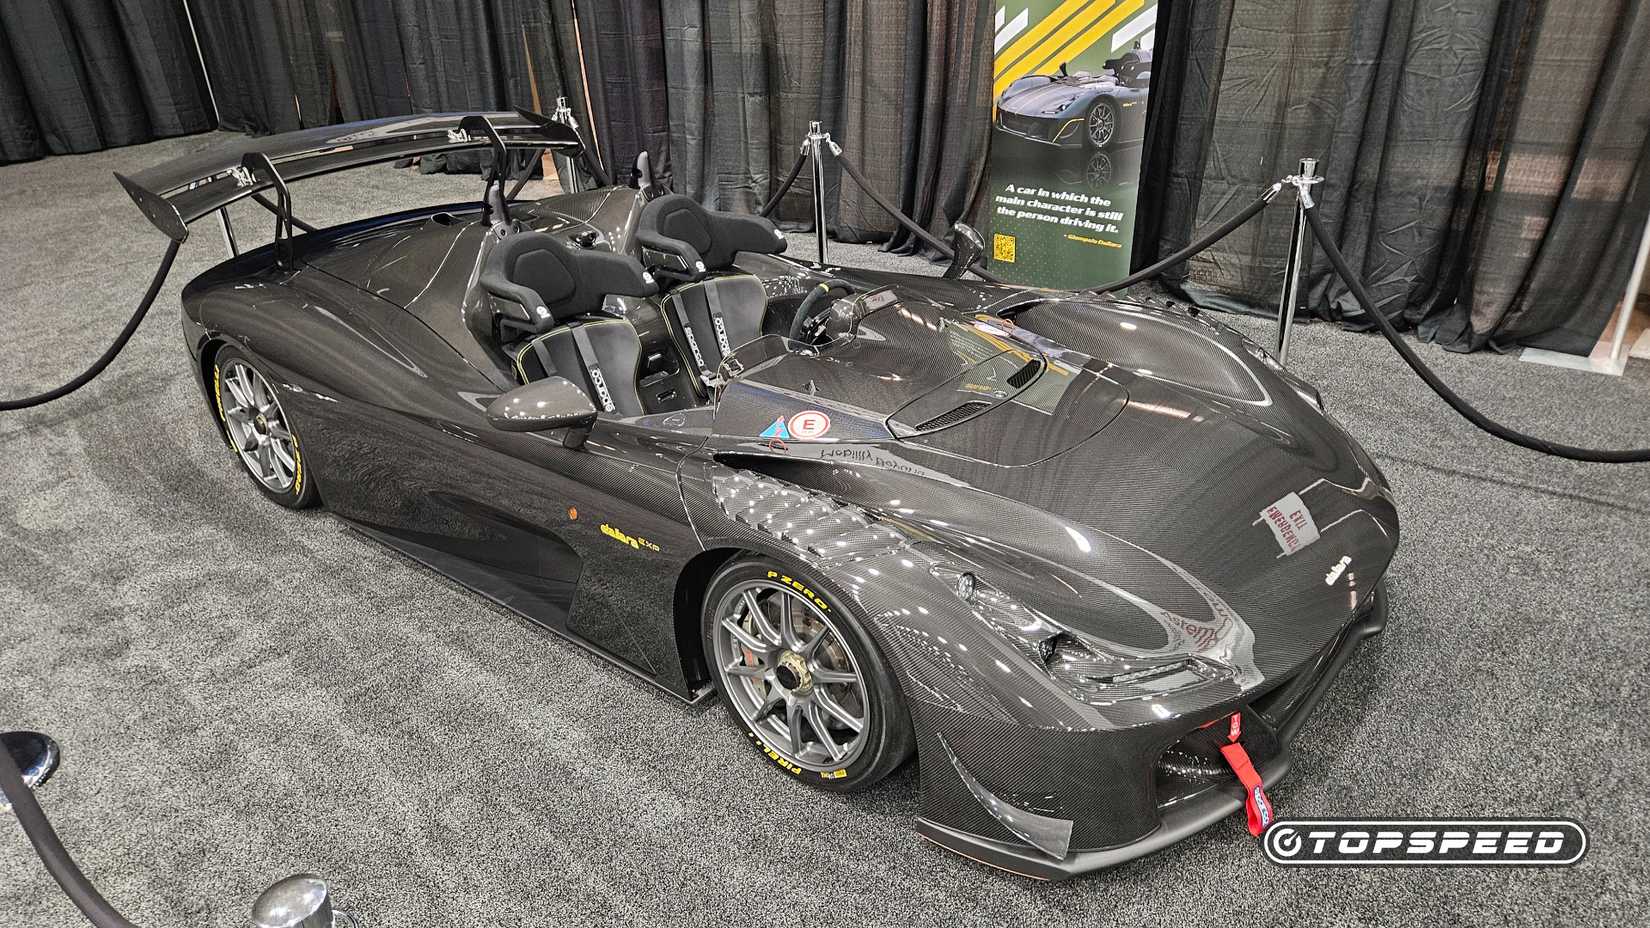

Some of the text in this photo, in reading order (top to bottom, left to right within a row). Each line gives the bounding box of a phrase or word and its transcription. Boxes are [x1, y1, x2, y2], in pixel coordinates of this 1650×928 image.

[995, 195, 1124, 221] main character is still
[1005, 184, 1111, 207] A car in which the
[997, 206, 1119, 233] the person driving it.
[802, 419, 816, 430] E
[767, 570, 828, 610] P ZERO
